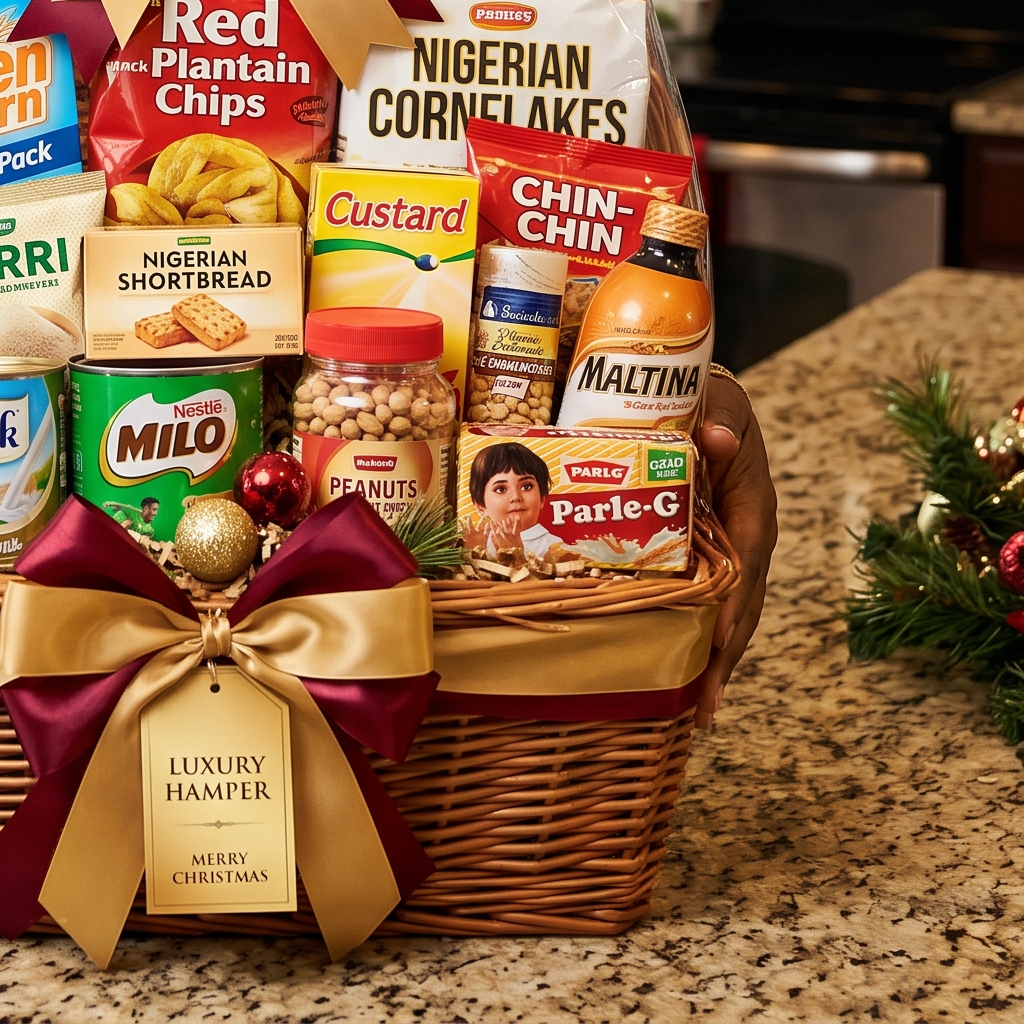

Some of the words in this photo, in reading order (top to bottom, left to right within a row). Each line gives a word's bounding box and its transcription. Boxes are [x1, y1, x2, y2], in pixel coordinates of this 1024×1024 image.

[151, 47, 311, 84] Plantain
[412, 37, 592, 90] NIGERIAN
[155, 83, 266, 126] Chips
[325, 190, 470, 234] Custard
[511, 175, 634, 221] CHIN-
[517, 212, 623, 256] CHIN
[143, 249, 248, 269] NIGERIAN
[118, 270, 272, 291] SHORTBREAD
[577, 355, 700, 396] MALTINA
[116, 416, 226, 463] MILO
[330, 476, 418, 499] PEANUTS
[549, 490, 681, 526] Parle-G
[169, 755, 267, 776] LUXURY
[165, 780, 272, 802] HAMPER
[172, 869, 269, 885] CHRISTMAS
[191, 851, 249, 867] MERRY
